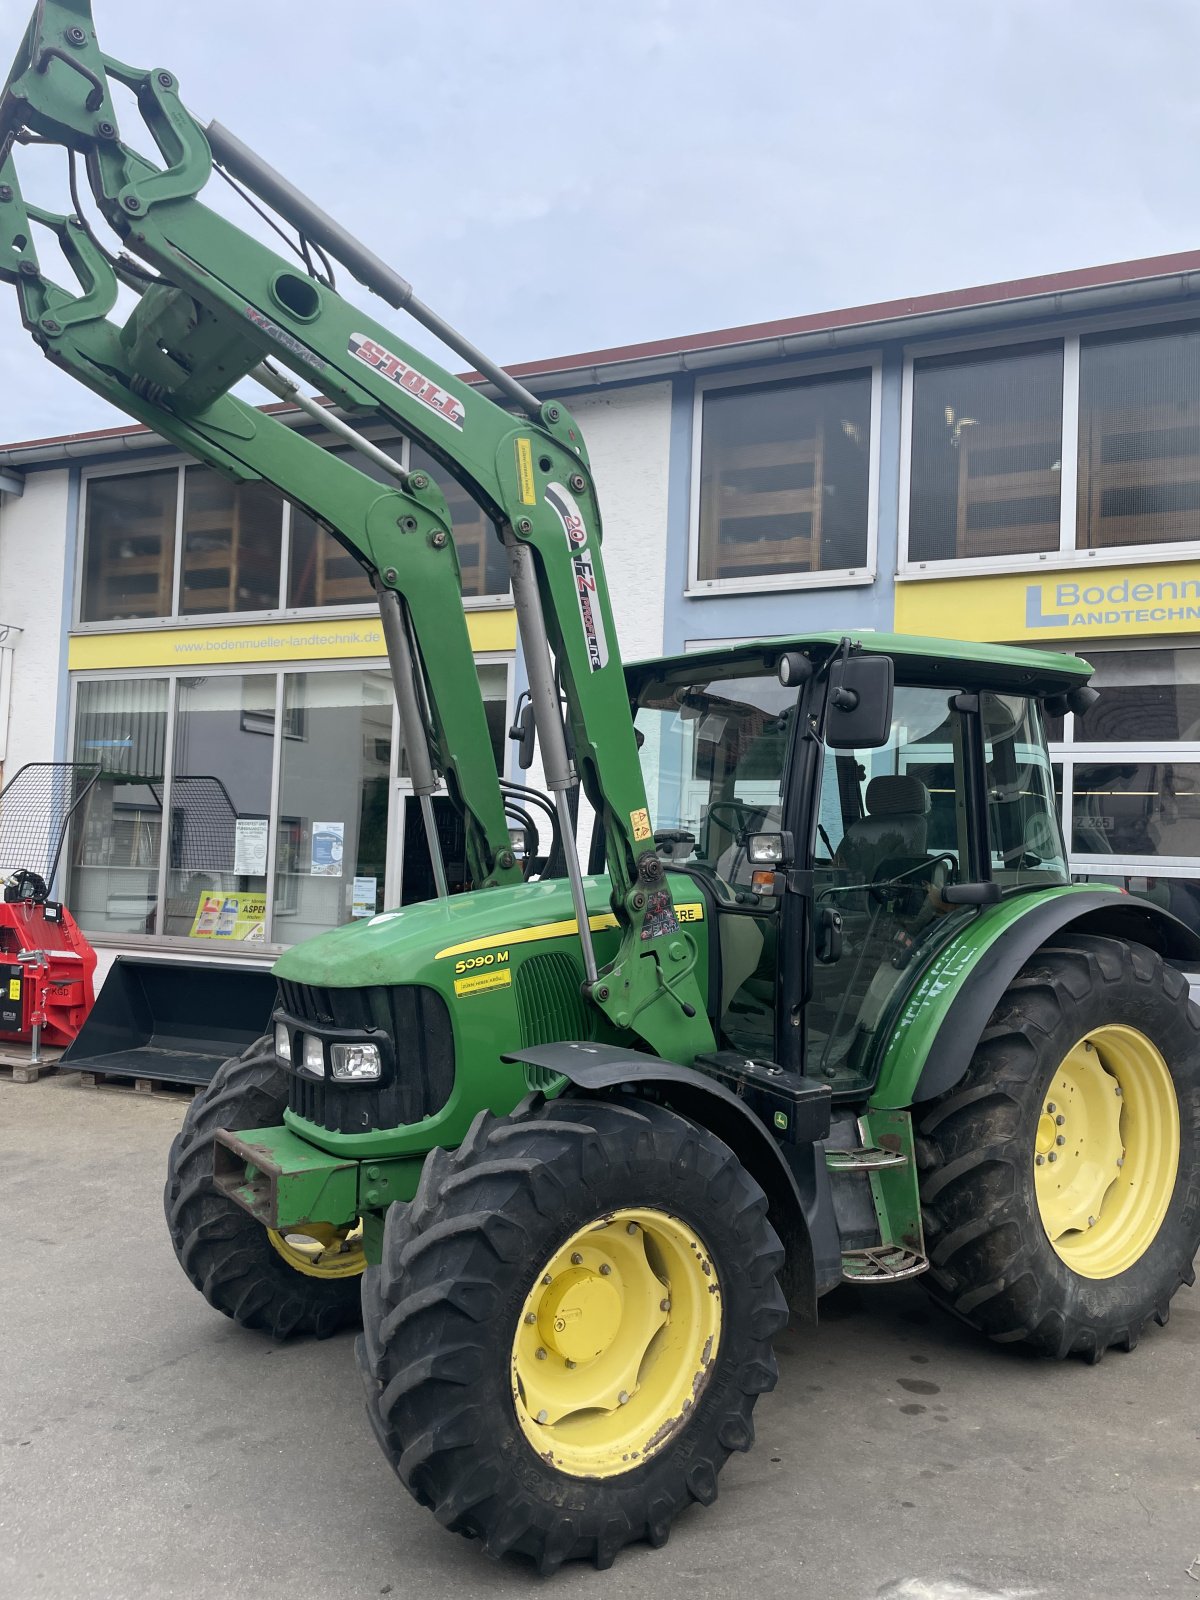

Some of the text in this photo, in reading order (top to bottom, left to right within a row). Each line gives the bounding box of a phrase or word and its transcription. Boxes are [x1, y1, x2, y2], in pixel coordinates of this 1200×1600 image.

[355, 340, 459, 422] STOLL
[565, 515, 585, 543] 20
[575, 561, 596, 592] FZ
[174, 632, 380, 653] www.bodenmueller-landtechnik.de
[455, 950, 510, 974] 5090 M
